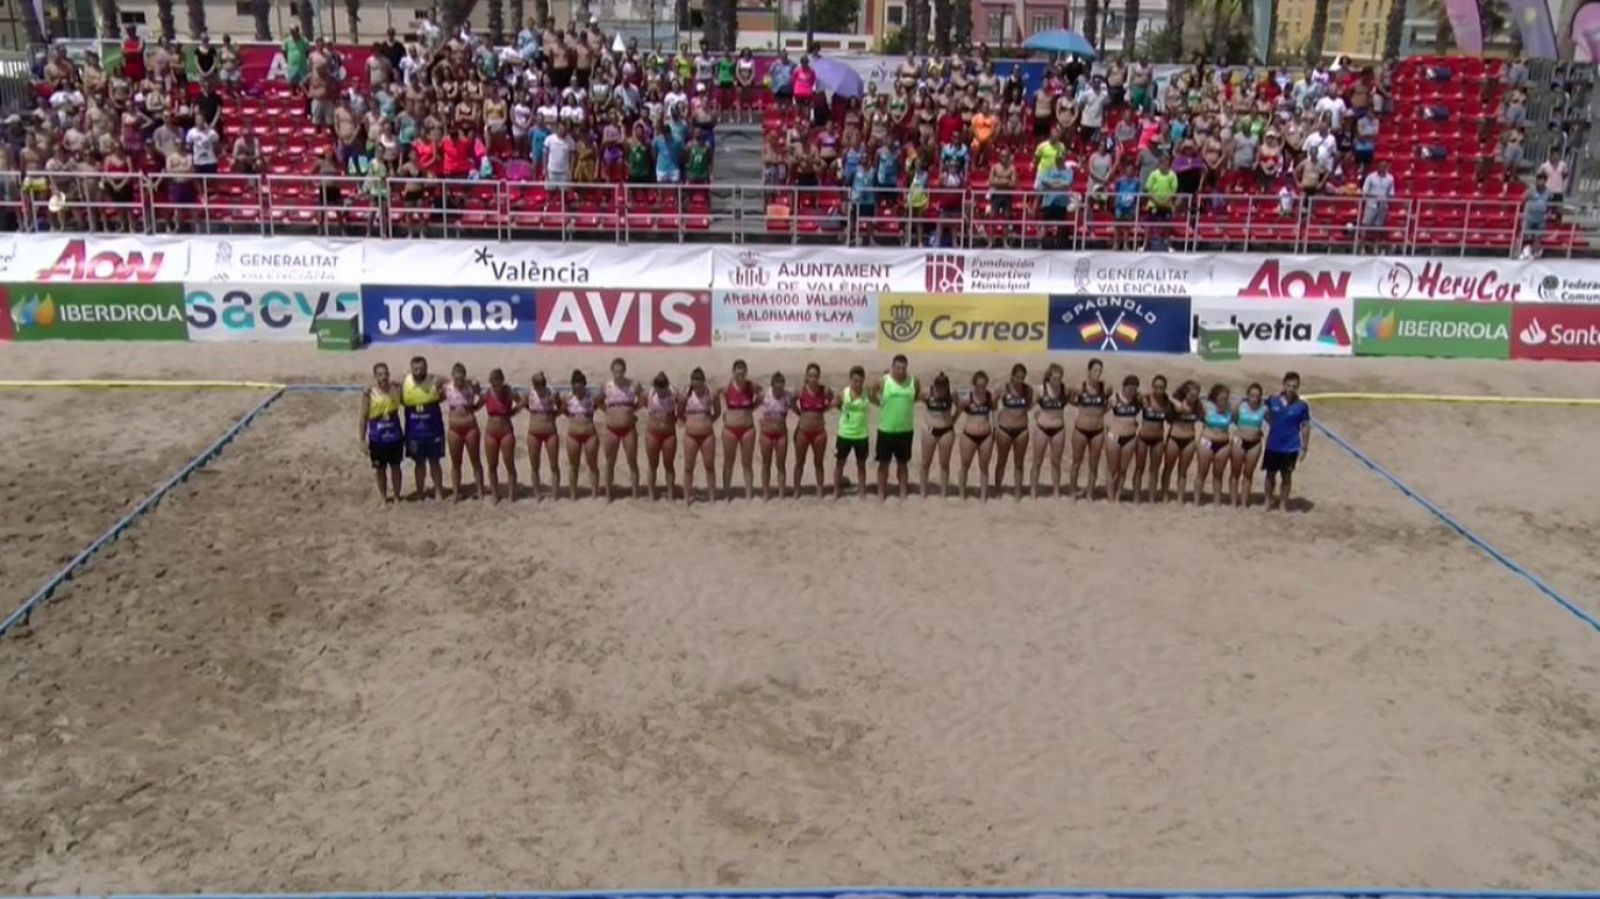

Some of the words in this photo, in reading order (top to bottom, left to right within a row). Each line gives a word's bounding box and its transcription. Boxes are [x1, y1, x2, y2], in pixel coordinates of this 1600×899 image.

[240, 254, 339, 267] GENERALITAT
[778, 262, 893, 278] AJUNTAMENT
[490, 261, 590, 282] València
[1096, 268, 1189, 280] GENERALITAT
[1418, 260, 1521, 301] HeryCor
[1097, 283, 1187, 295] VALENCIANA
[60, 303, 184, 322] IBERDROLA
[540, 290, 696, 345] AVIS
[737, 308, 812, 322] BALONMANO
[815, 309, 854, 323] PLAYA
[1061, 295, 1158, 325] SPAGNOLO
[929, 314, 1045, 341] Correos
[1398, 319, 1509, 341] IBERDROLA
